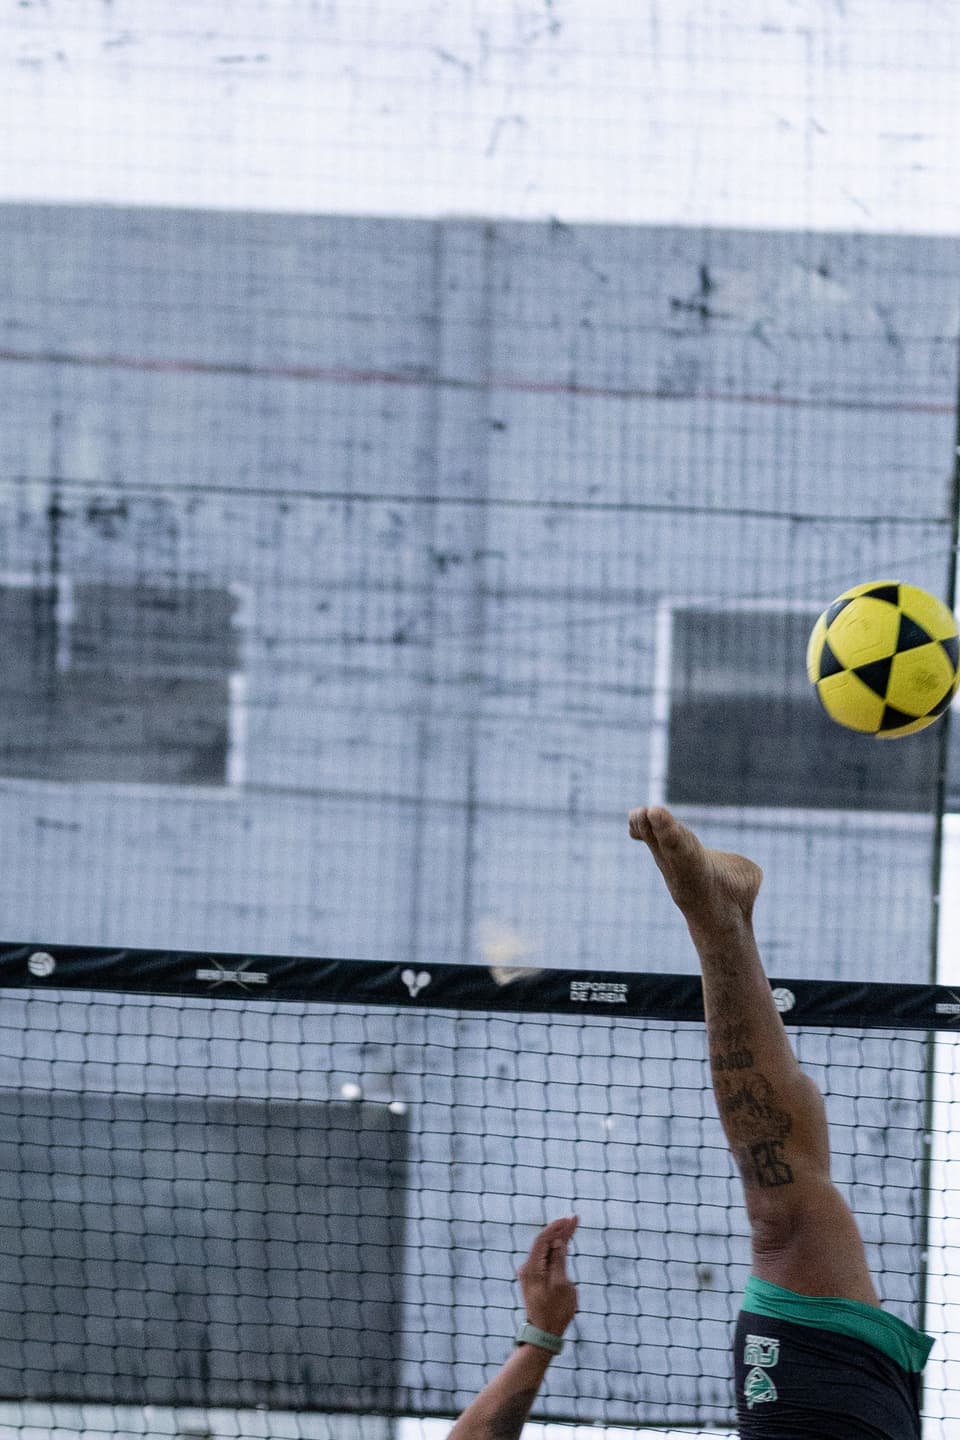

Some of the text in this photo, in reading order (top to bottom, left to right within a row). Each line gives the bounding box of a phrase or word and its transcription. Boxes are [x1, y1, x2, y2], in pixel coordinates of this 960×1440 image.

[570, 981, 629, 992] ESPORTES
[570, 991, 627, 1003] DE AREIA
